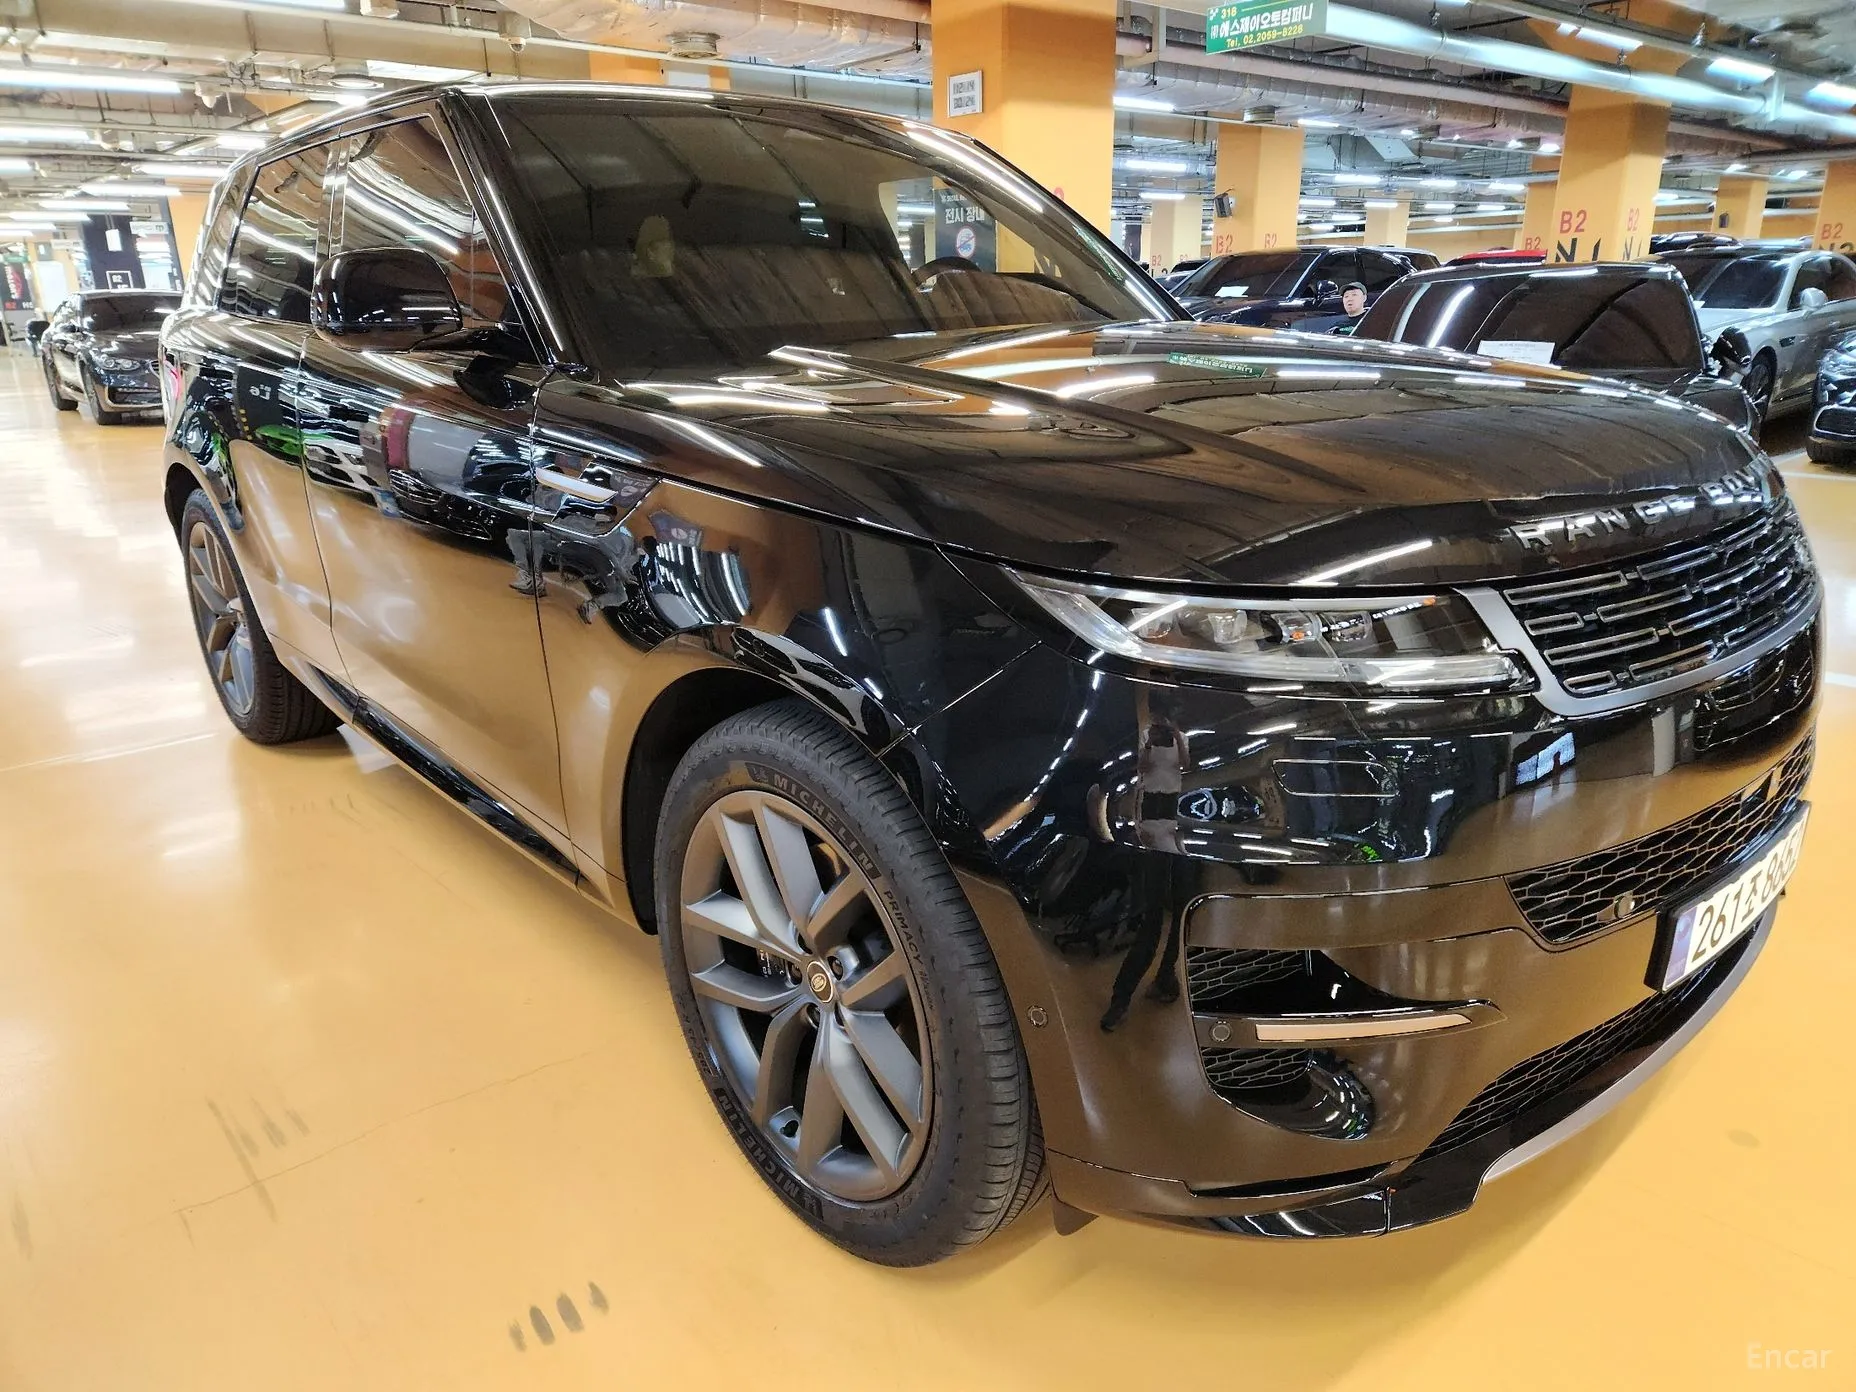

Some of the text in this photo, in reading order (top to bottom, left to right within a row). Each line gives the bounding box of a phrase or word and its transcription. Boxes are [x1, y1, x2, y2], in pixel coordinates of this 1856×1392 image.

[945, 207, 964, 224] 전시
[1560, 210, 1587, 234] B2
[1627, 203, 1640, 231] B2
[1215, 234, 1233, 253] B2
[1264, 233, 1277, 249] B2
[1525, 236, 1541, 251] B2
[1821, 223, 1843, 240] B2
[1509, 494, 1698, 549] RANGE
[773, 773, 876, 873] MICHELIN
[884, 888, 924, 965] PRIMACY
[718, 1093, 801, 1199] MICHELIN
